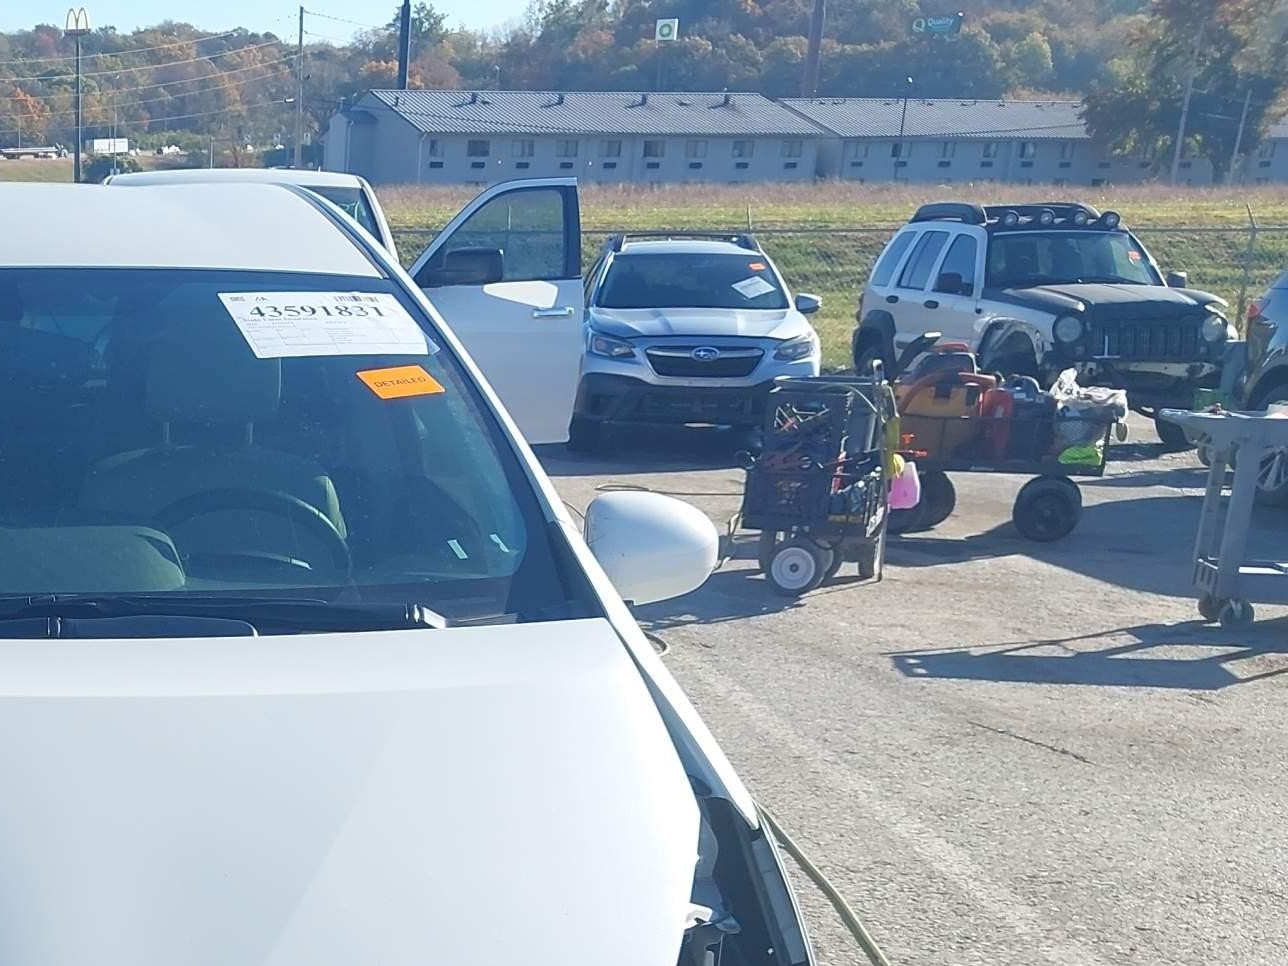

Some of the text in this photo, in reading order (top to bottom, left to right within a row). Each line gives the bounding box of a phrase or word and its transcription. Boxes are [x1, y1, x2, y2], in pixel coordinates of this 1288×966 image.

[927, 17, 954, 27] Quality
[249, 304, 385, 318] 43591831
[373, 376, 427, 388] DETAILED
